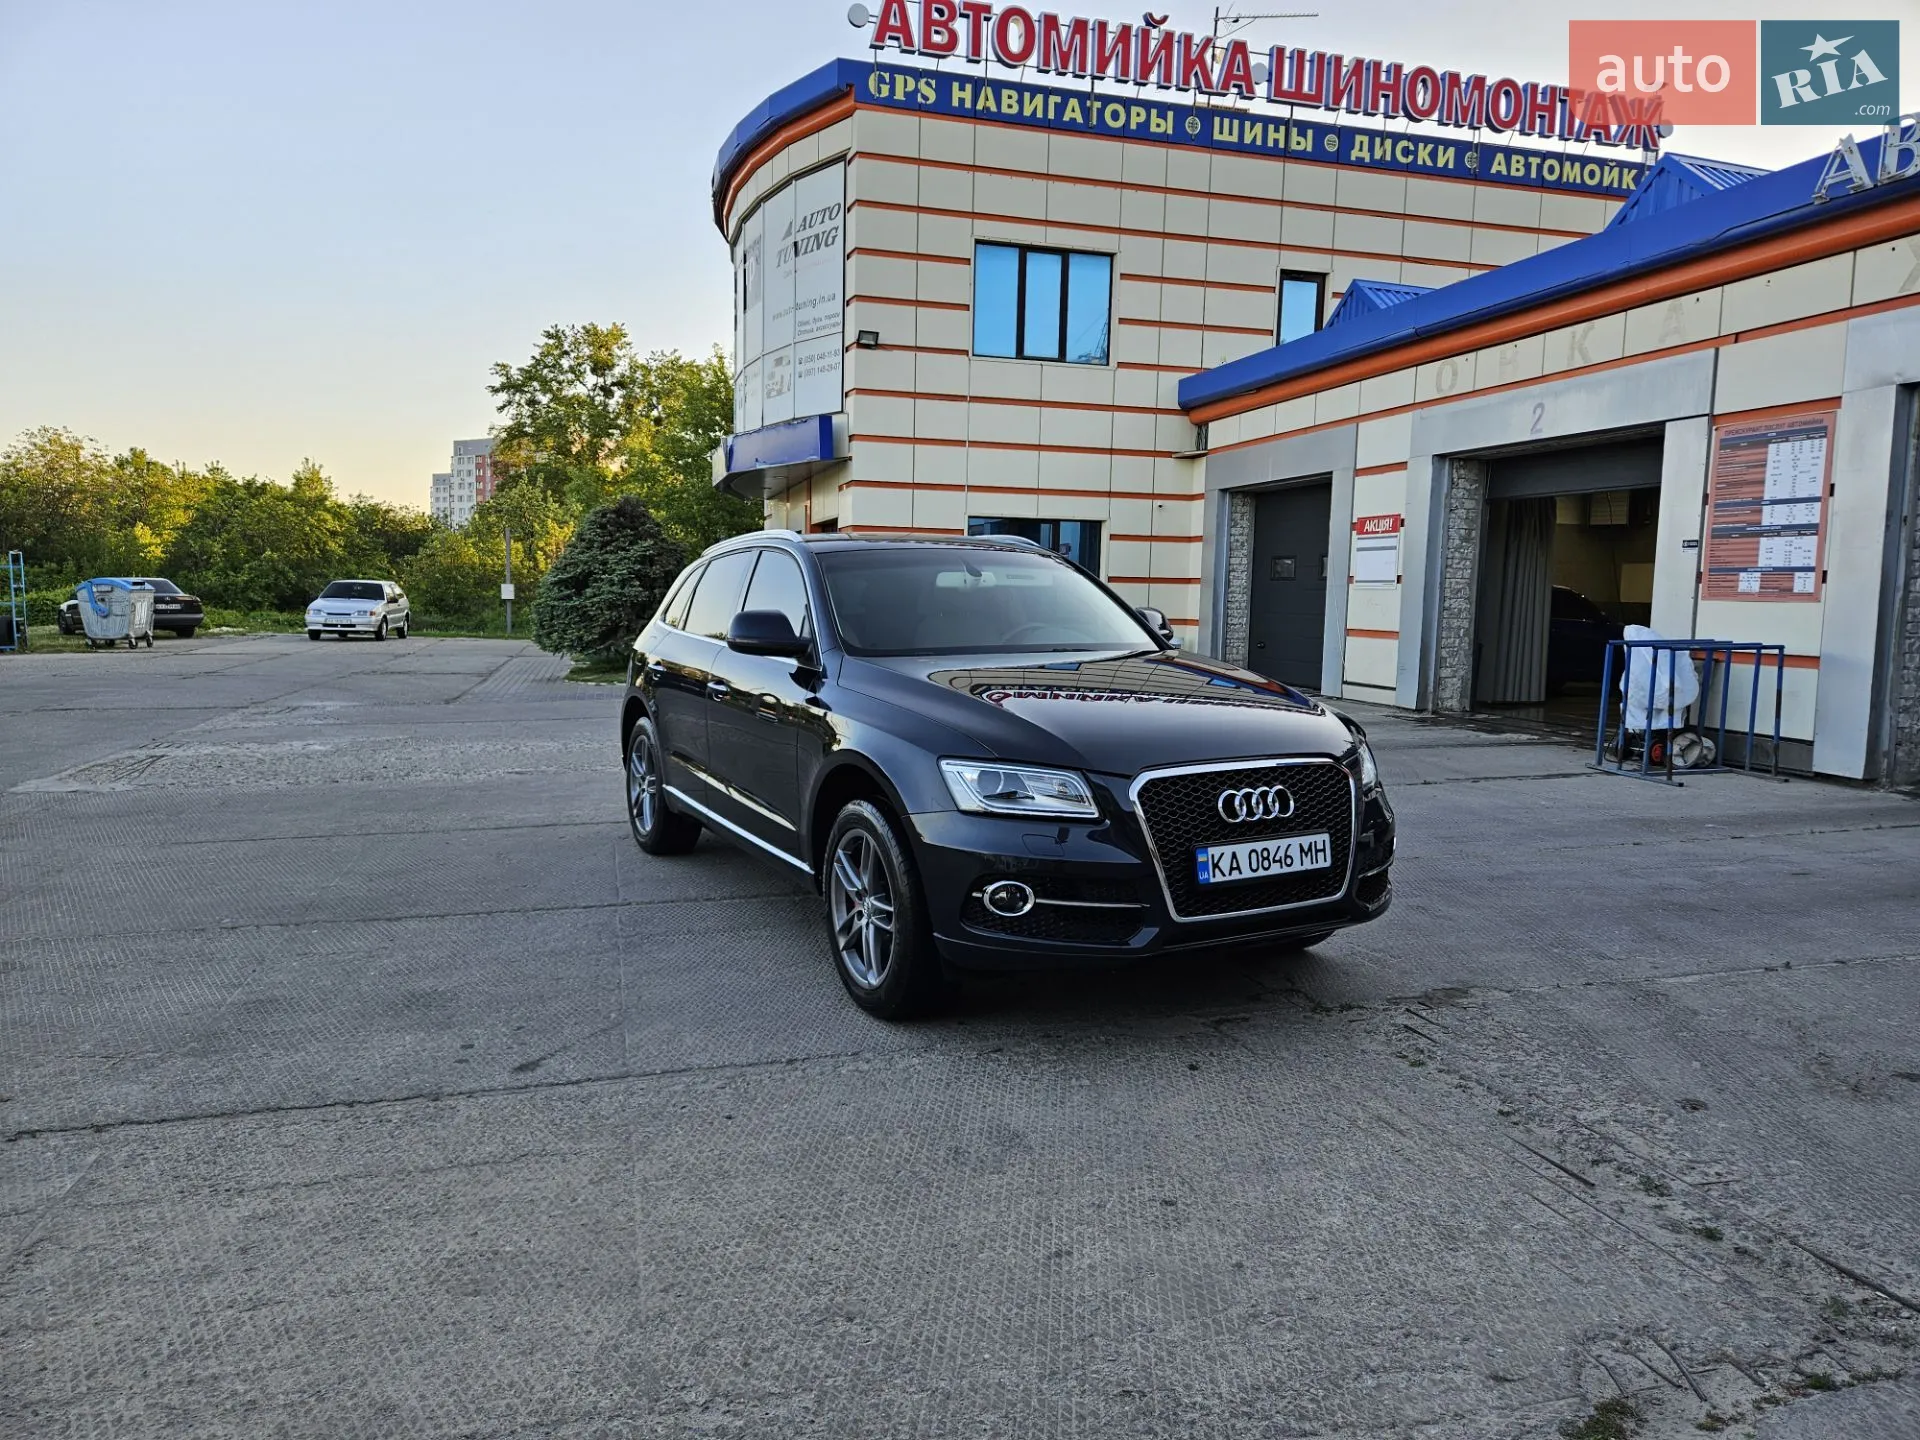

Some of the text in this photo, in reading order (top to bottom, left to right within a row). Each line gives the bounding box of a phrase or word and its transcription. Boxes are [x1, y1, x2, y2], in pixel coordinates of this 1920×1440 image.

[869, 0, 1661, 150] АВТОМИЙКА ШИНОМОНТАЖ
[867, 70, 937, 105] GPS
[951, 81, 1174, 136] НАВИГАТОРЫ
[1212, 115, 1313, 153] ШИНЫ
[1349, 134, 1457, 169] ДИСКИ
[796, 202, 841, 233] AUTO
[775, 225, 840, 269] TUNING
[1529, 402, 1544, 434] 2
[1211, 839, 1327, 879] KA 0846 MH
